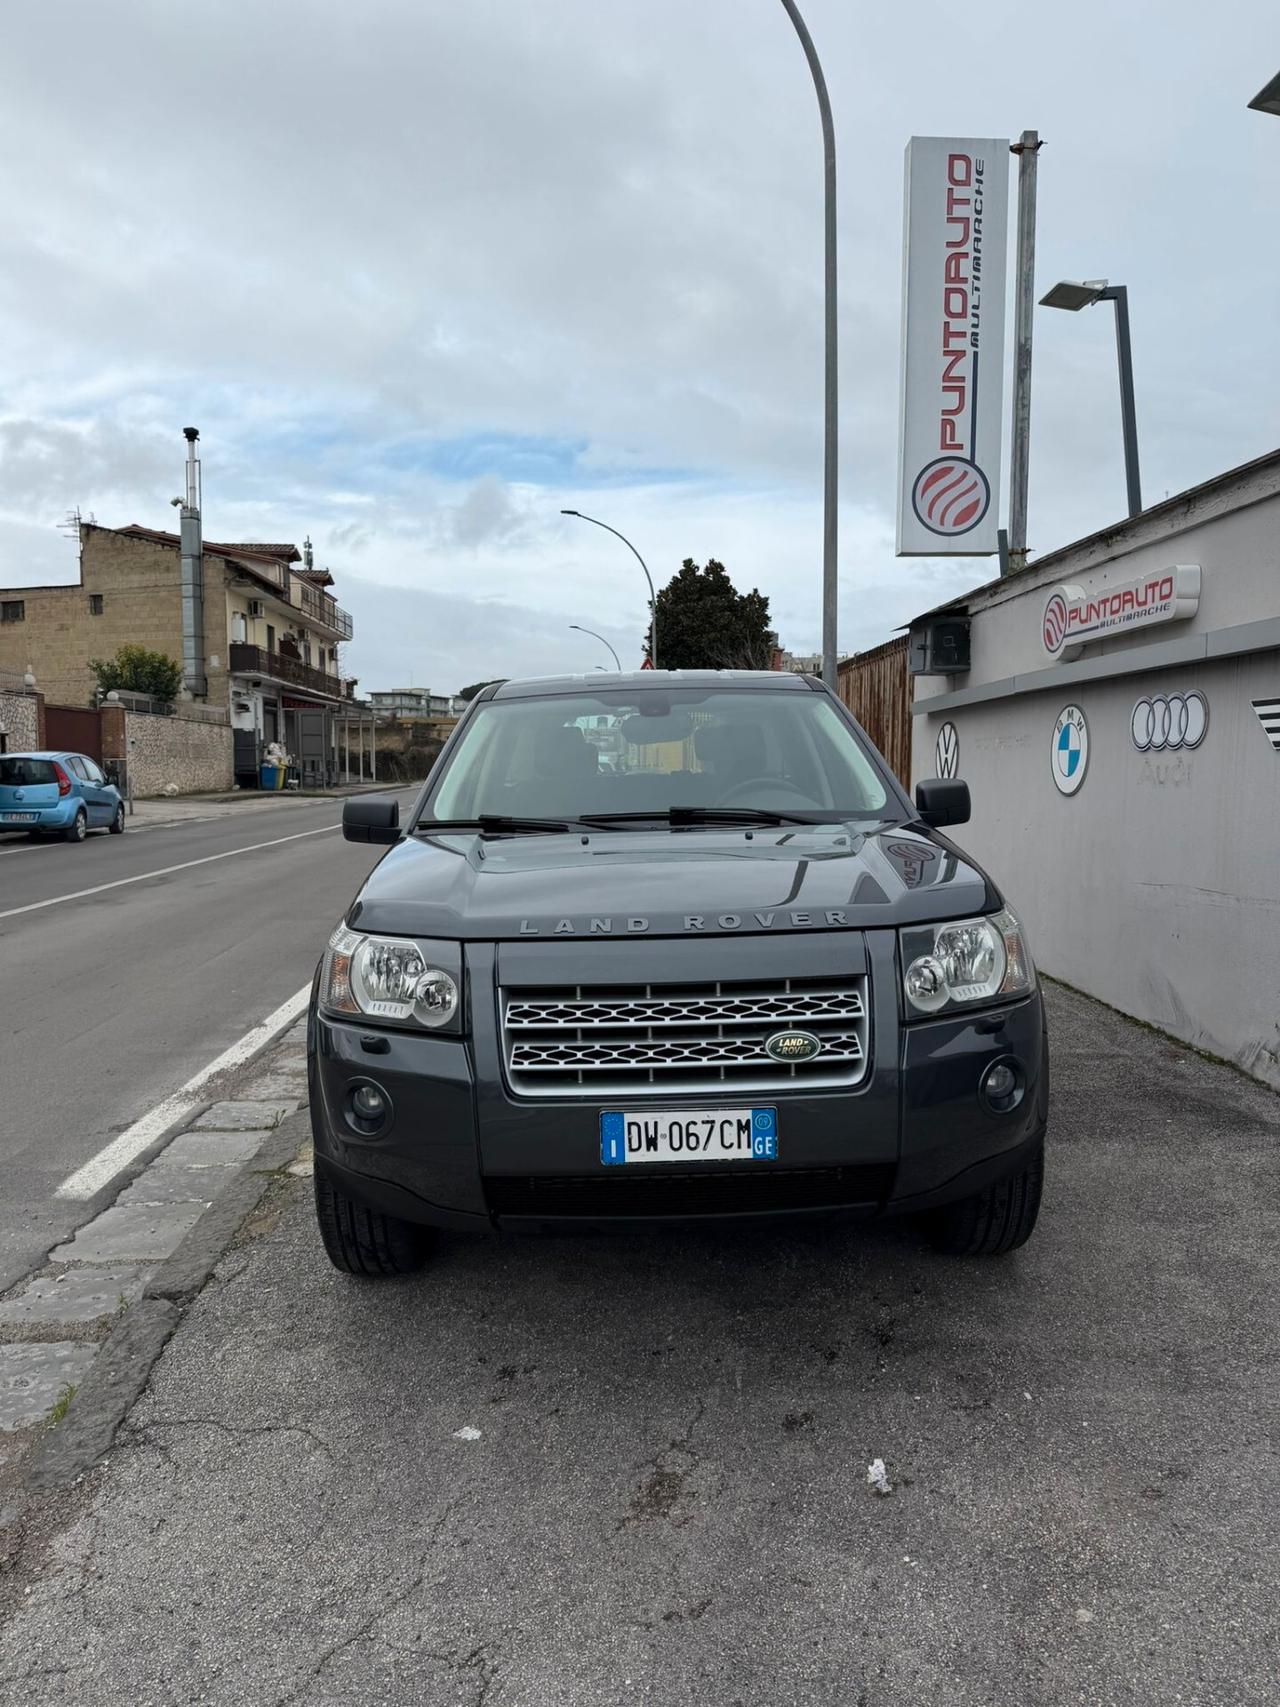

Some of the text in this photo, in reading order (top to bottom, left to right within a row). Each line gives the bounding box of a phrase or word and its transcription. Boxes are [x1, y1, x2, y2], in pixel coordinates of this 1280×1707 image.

[970, 157, 985, 349] MULTIMARCHE
[940, 154, 971, 450] PUNTOAUTO
[1068, 576, 1173, 628] PUNTOAUTO
[1100, 601, 1172, 628] MULTIMARCHE
[1056, 709, 1084, 734] BMW
[519, 910, 848, 934] LAND ROVER
[779, 1038, 803, 1047] LAND
[781, 1046, 811, 1054] ROVER
[754, 1136, 773, 1155] GE
